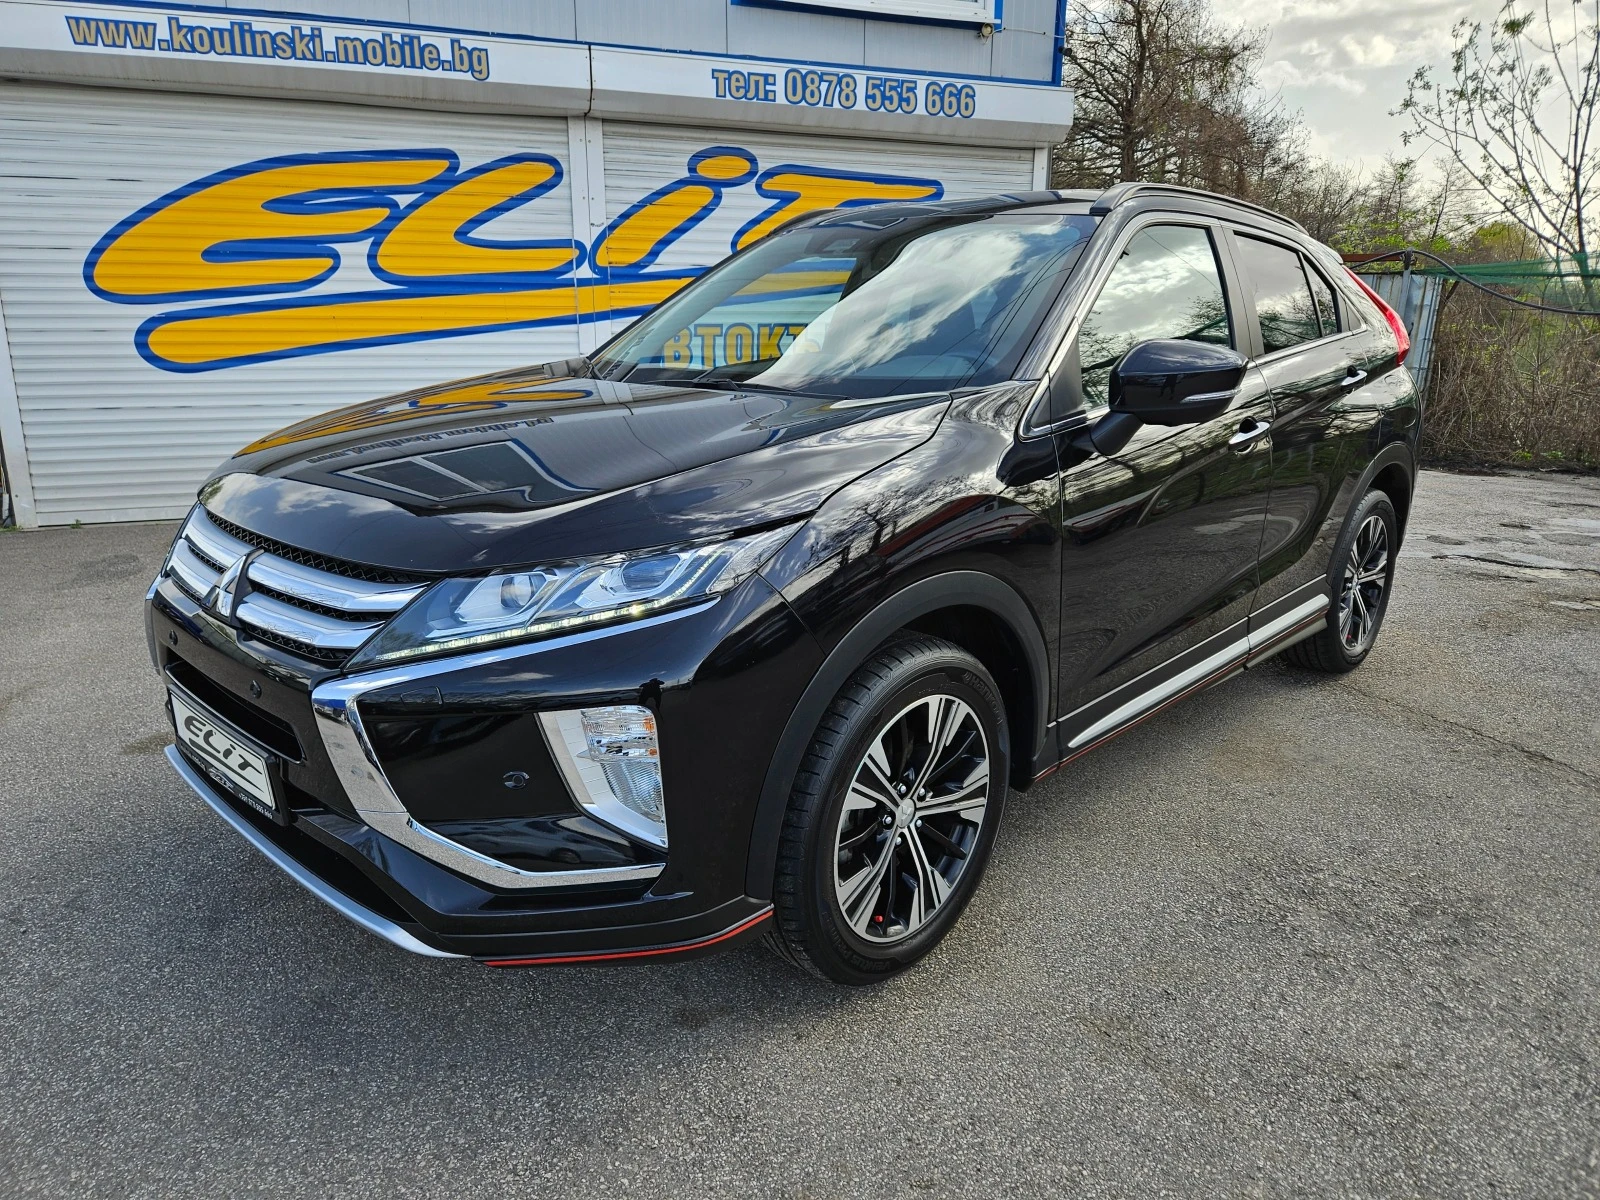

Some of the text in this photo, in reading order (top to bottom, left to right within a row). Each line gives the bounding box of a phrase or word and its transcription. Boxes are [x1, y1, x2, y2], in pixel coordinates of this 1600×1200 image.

[65, 15, 490, 81] www.koulinski.mobile.bg
[711, 67, 976, 119] тел: 0878 555 666
